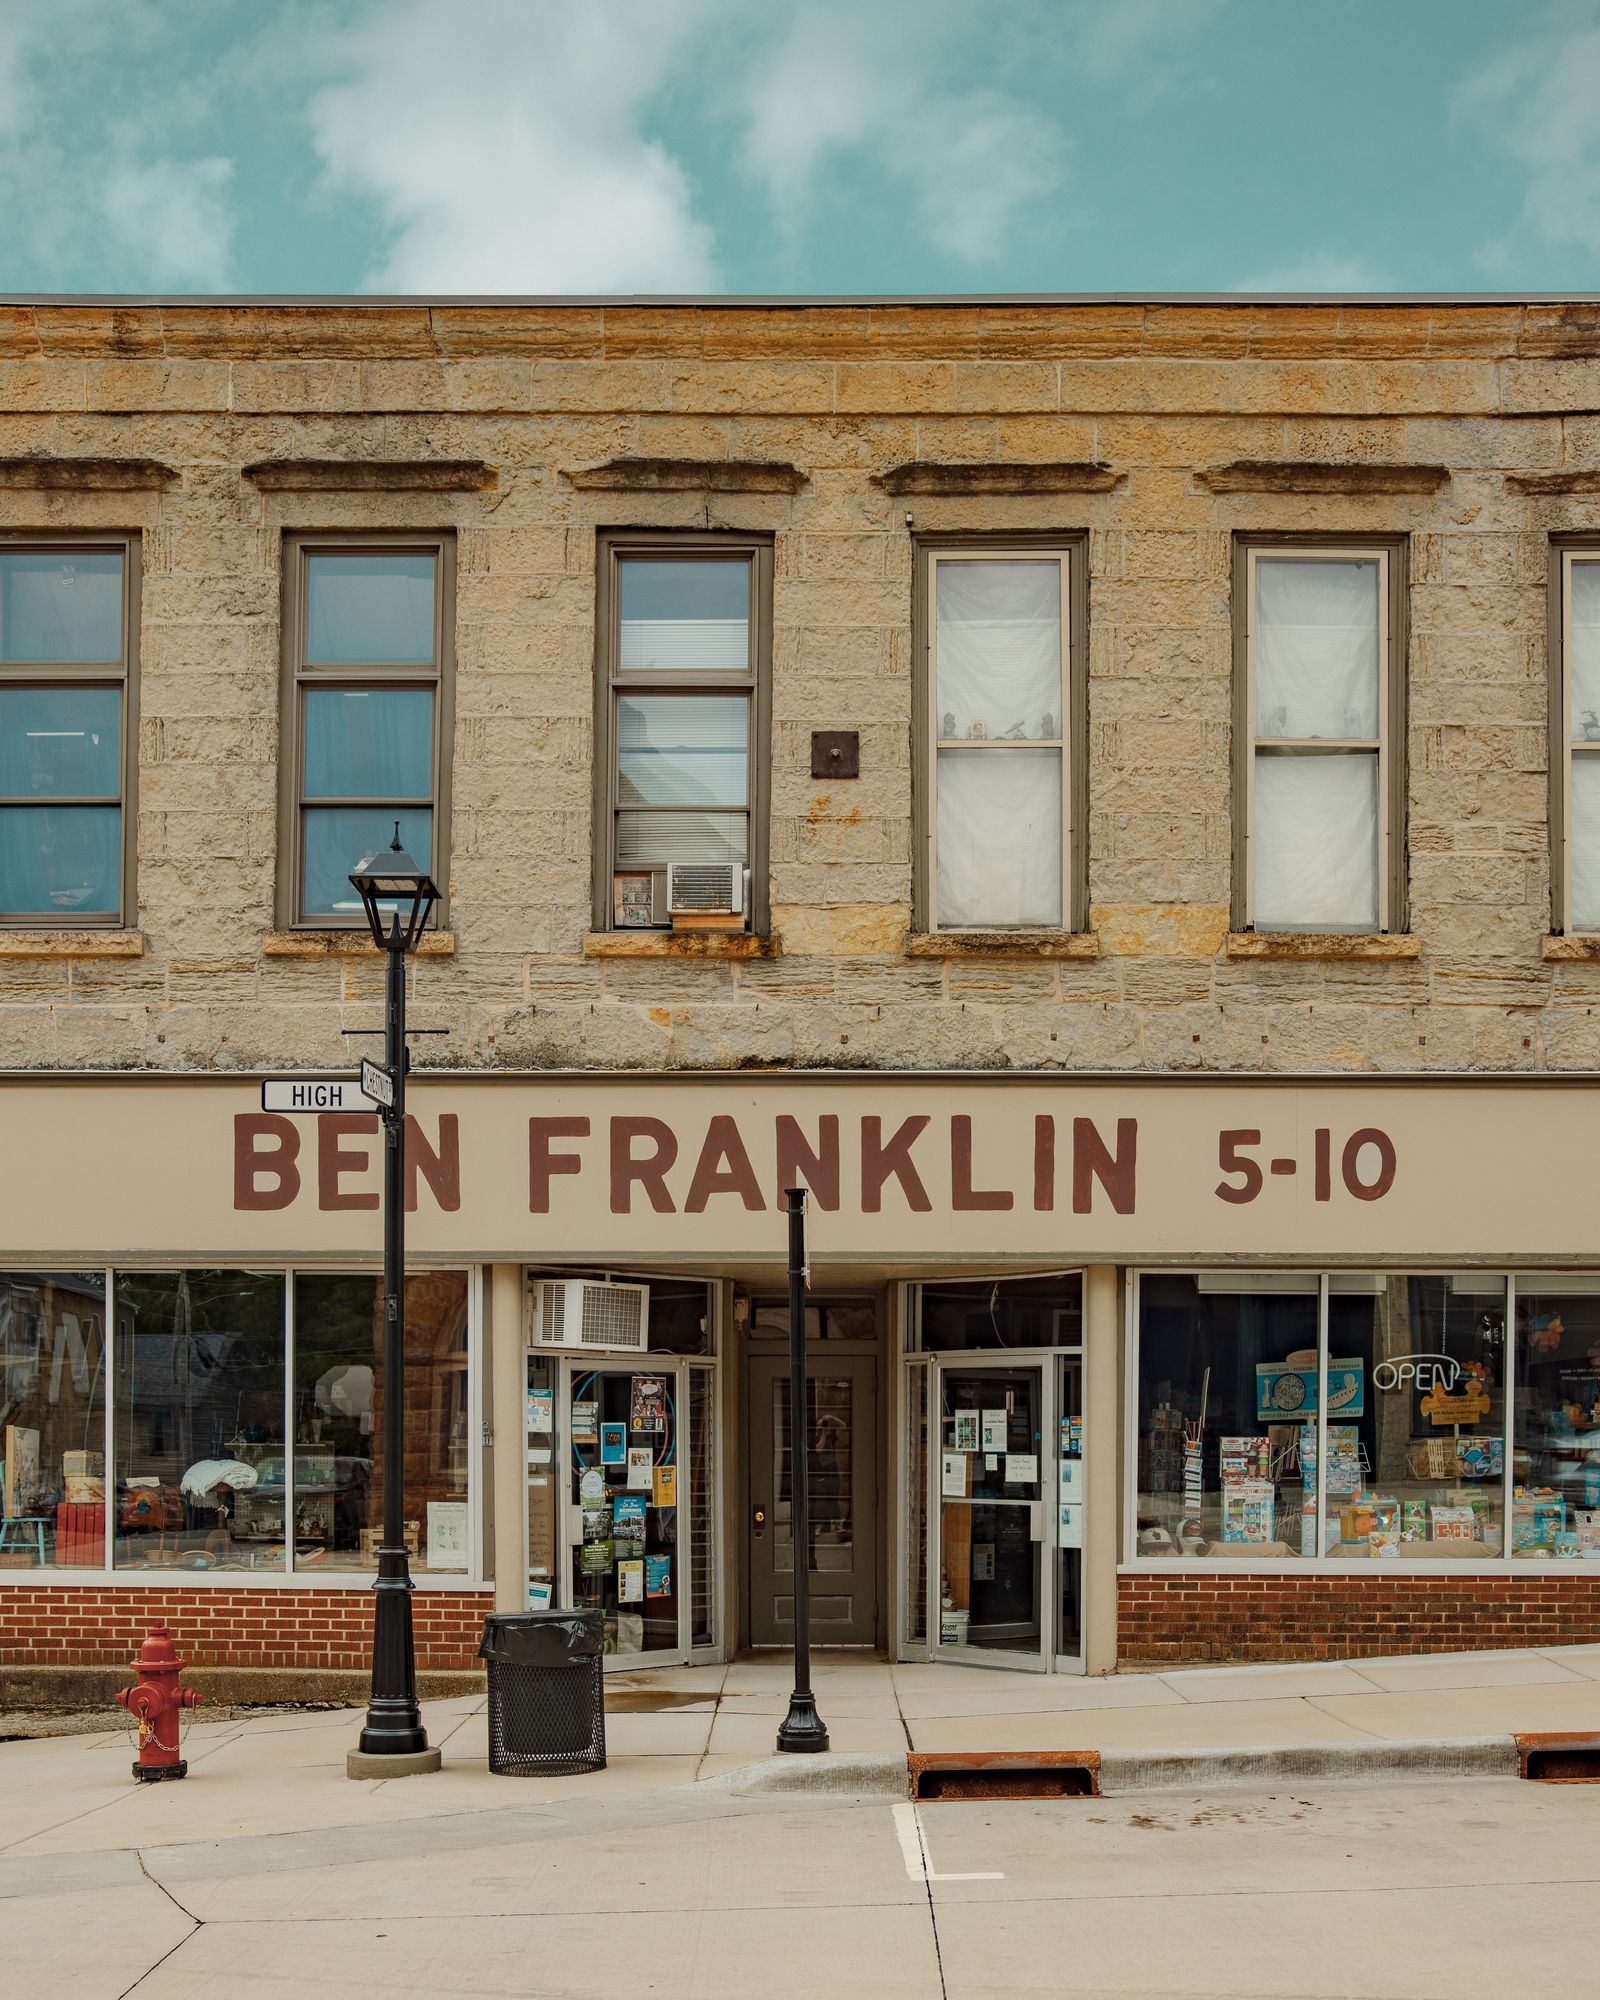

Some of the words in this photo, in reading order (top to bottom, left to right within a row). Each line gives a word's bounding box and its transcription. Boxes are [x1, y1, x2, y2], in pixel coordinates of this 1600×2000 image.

[292, 1085, 342, 1107] HIGH
[366, 1067, 389, 1102] CHESTNUT
[233, 1113, 460, 1212] BEN
[529, 1114, 1138, 1214] FRANKLIN
[1215, 1127, 1397, 1204] 5-10
[1373, 1362, 1454, 1391] OPEN
